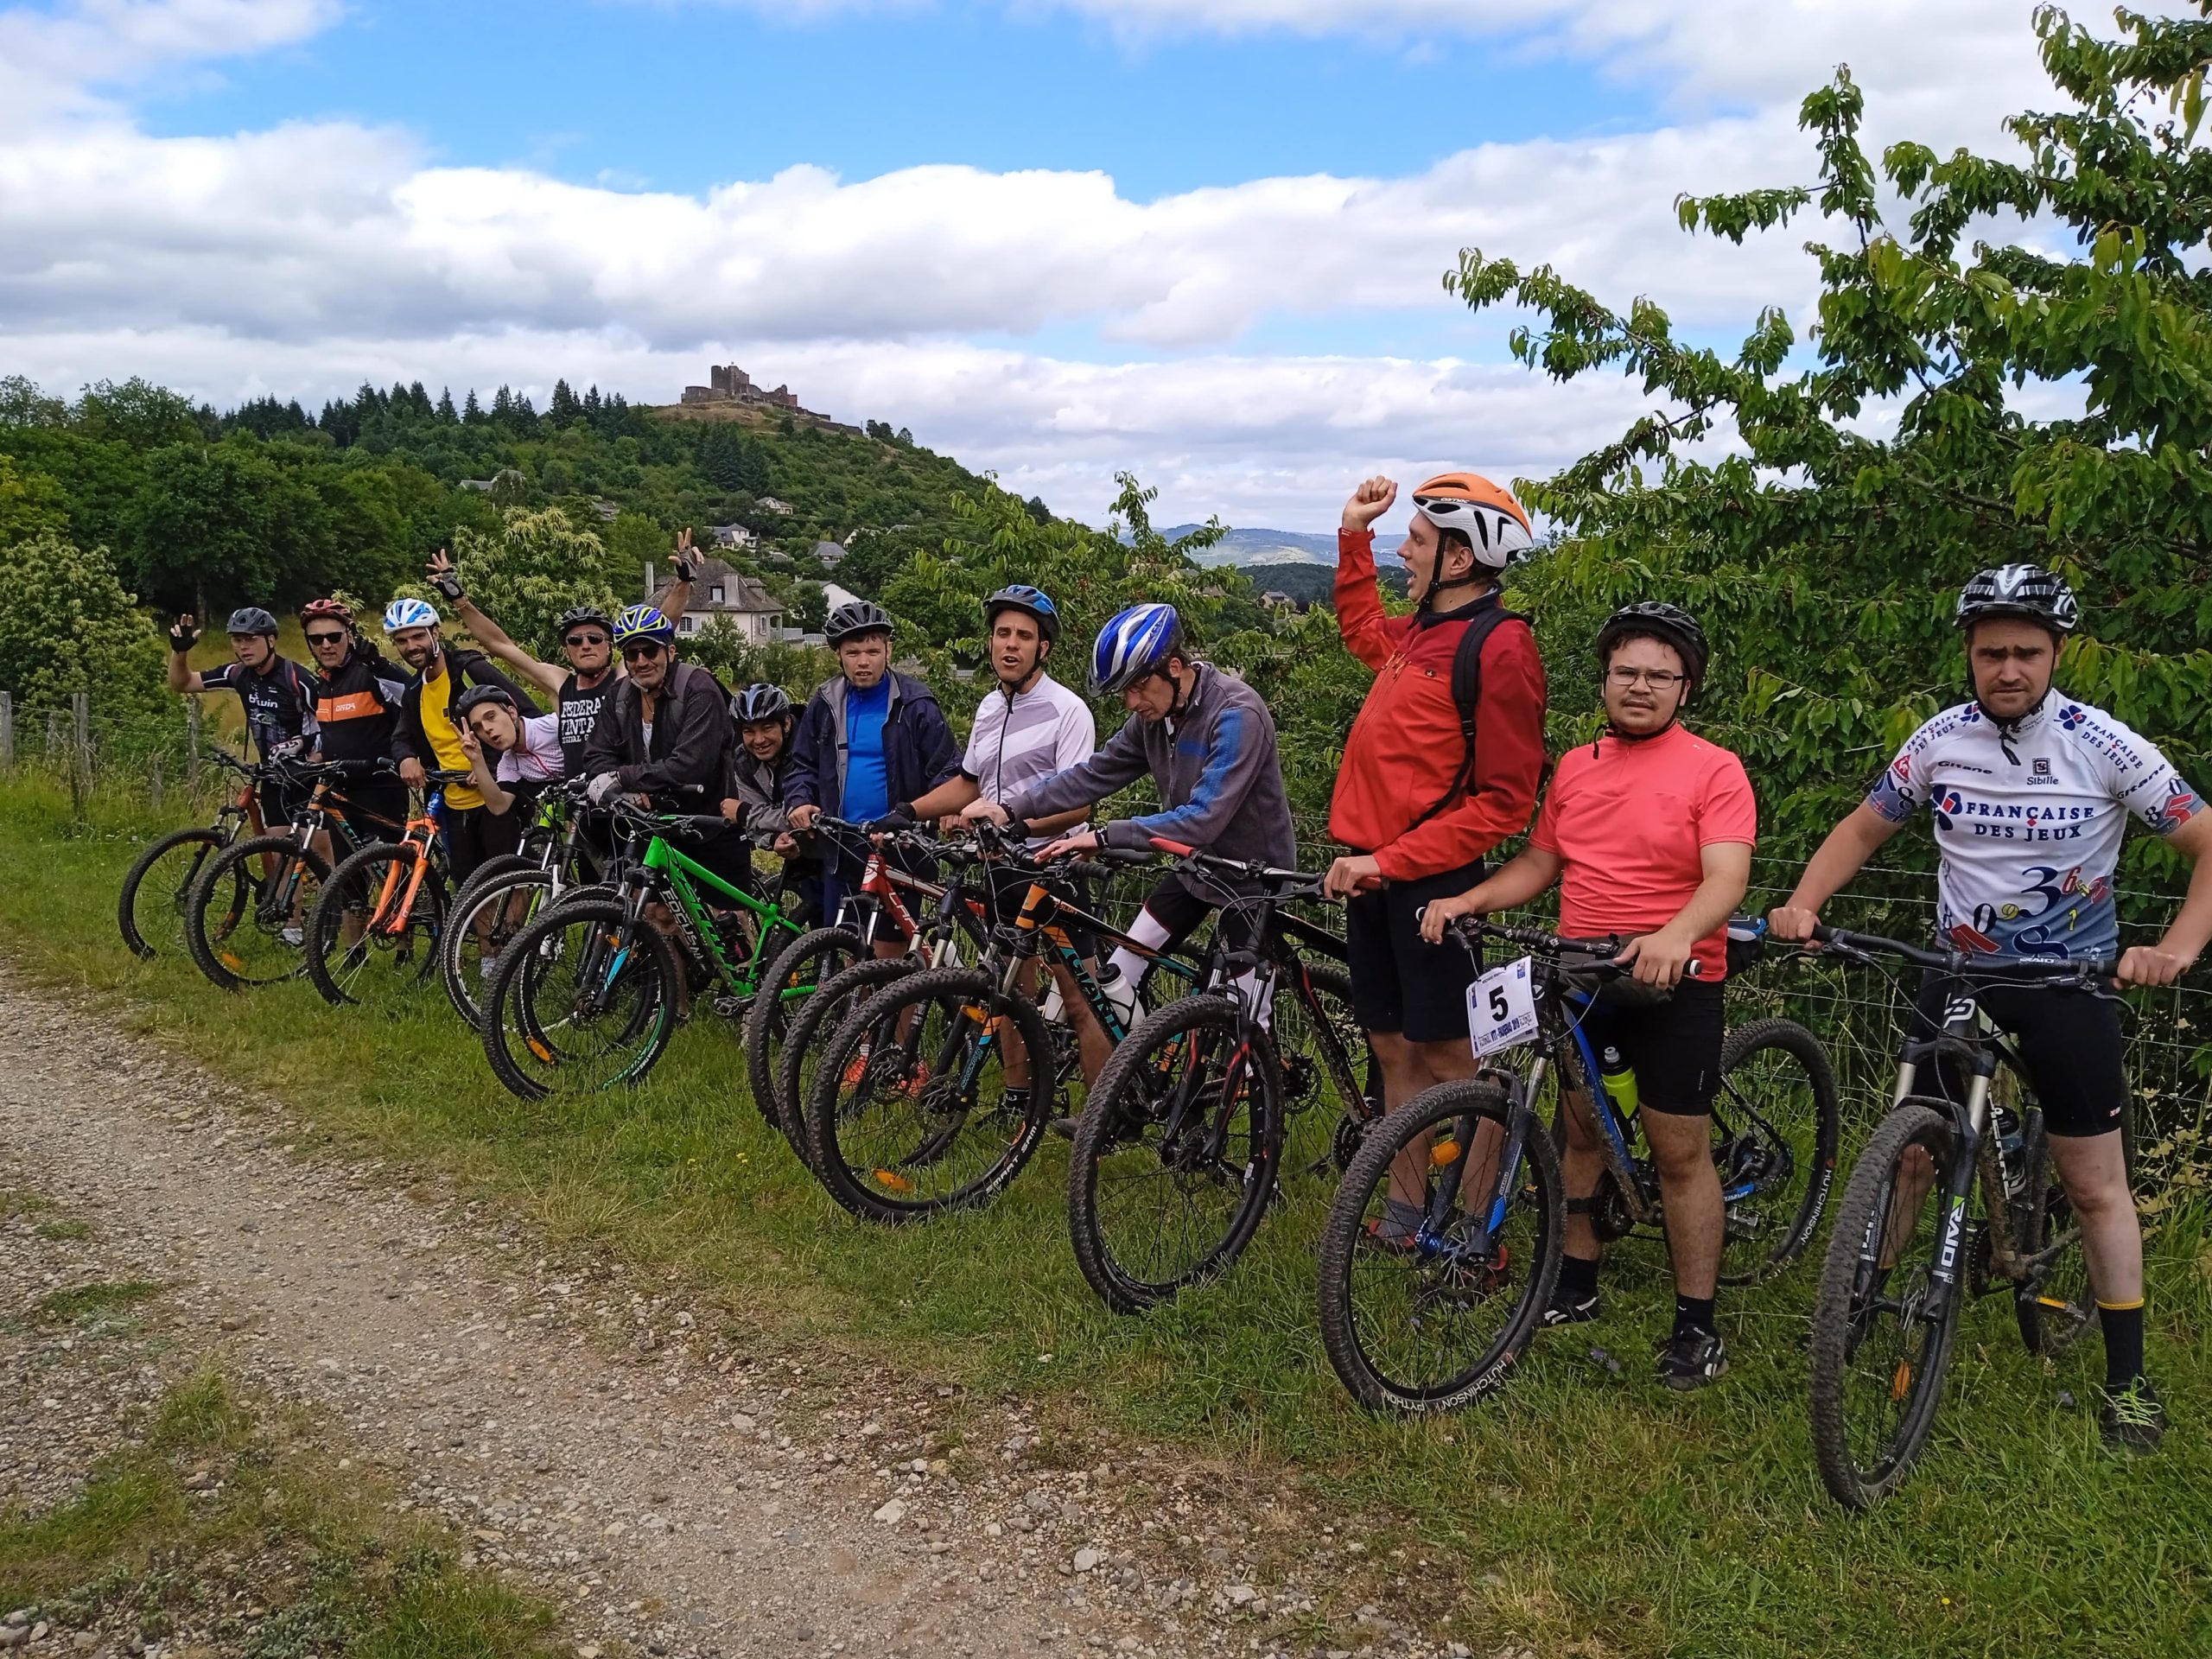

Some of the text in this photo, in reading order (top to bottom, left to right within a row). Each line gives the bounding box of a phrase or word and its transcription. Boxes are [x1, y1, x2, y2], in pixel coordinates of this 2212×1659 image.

[1931, 722, 1955, 741] JEUX
[2087, 721, 2144, 769] FRANÇAISE
[1938, 760, 1993, 774] Gitane
[2082, 732, 2129, 773] DES JEUX
[2026, 776, 2059, 785] Sibille
[2117, 764, 2165, 799] Gitane
[1966, 802, 2094, 823] FRANÇAISE
[1974, 823, 2082, 842] DES JEUX
[2020, 867, 2062, 916] 3
[662, 890, 697, 946] FOCUS
[1974, 903, 1997, 933] 0
[1489, 985, 1509, 1021] 5
[1800, 1169, 1833, 1243] HUTCHINSON
[1941, 1201, 1965, 1268] RAID
[1382, 1359, 1507, 1411] PYTHON HUTCHINSON
